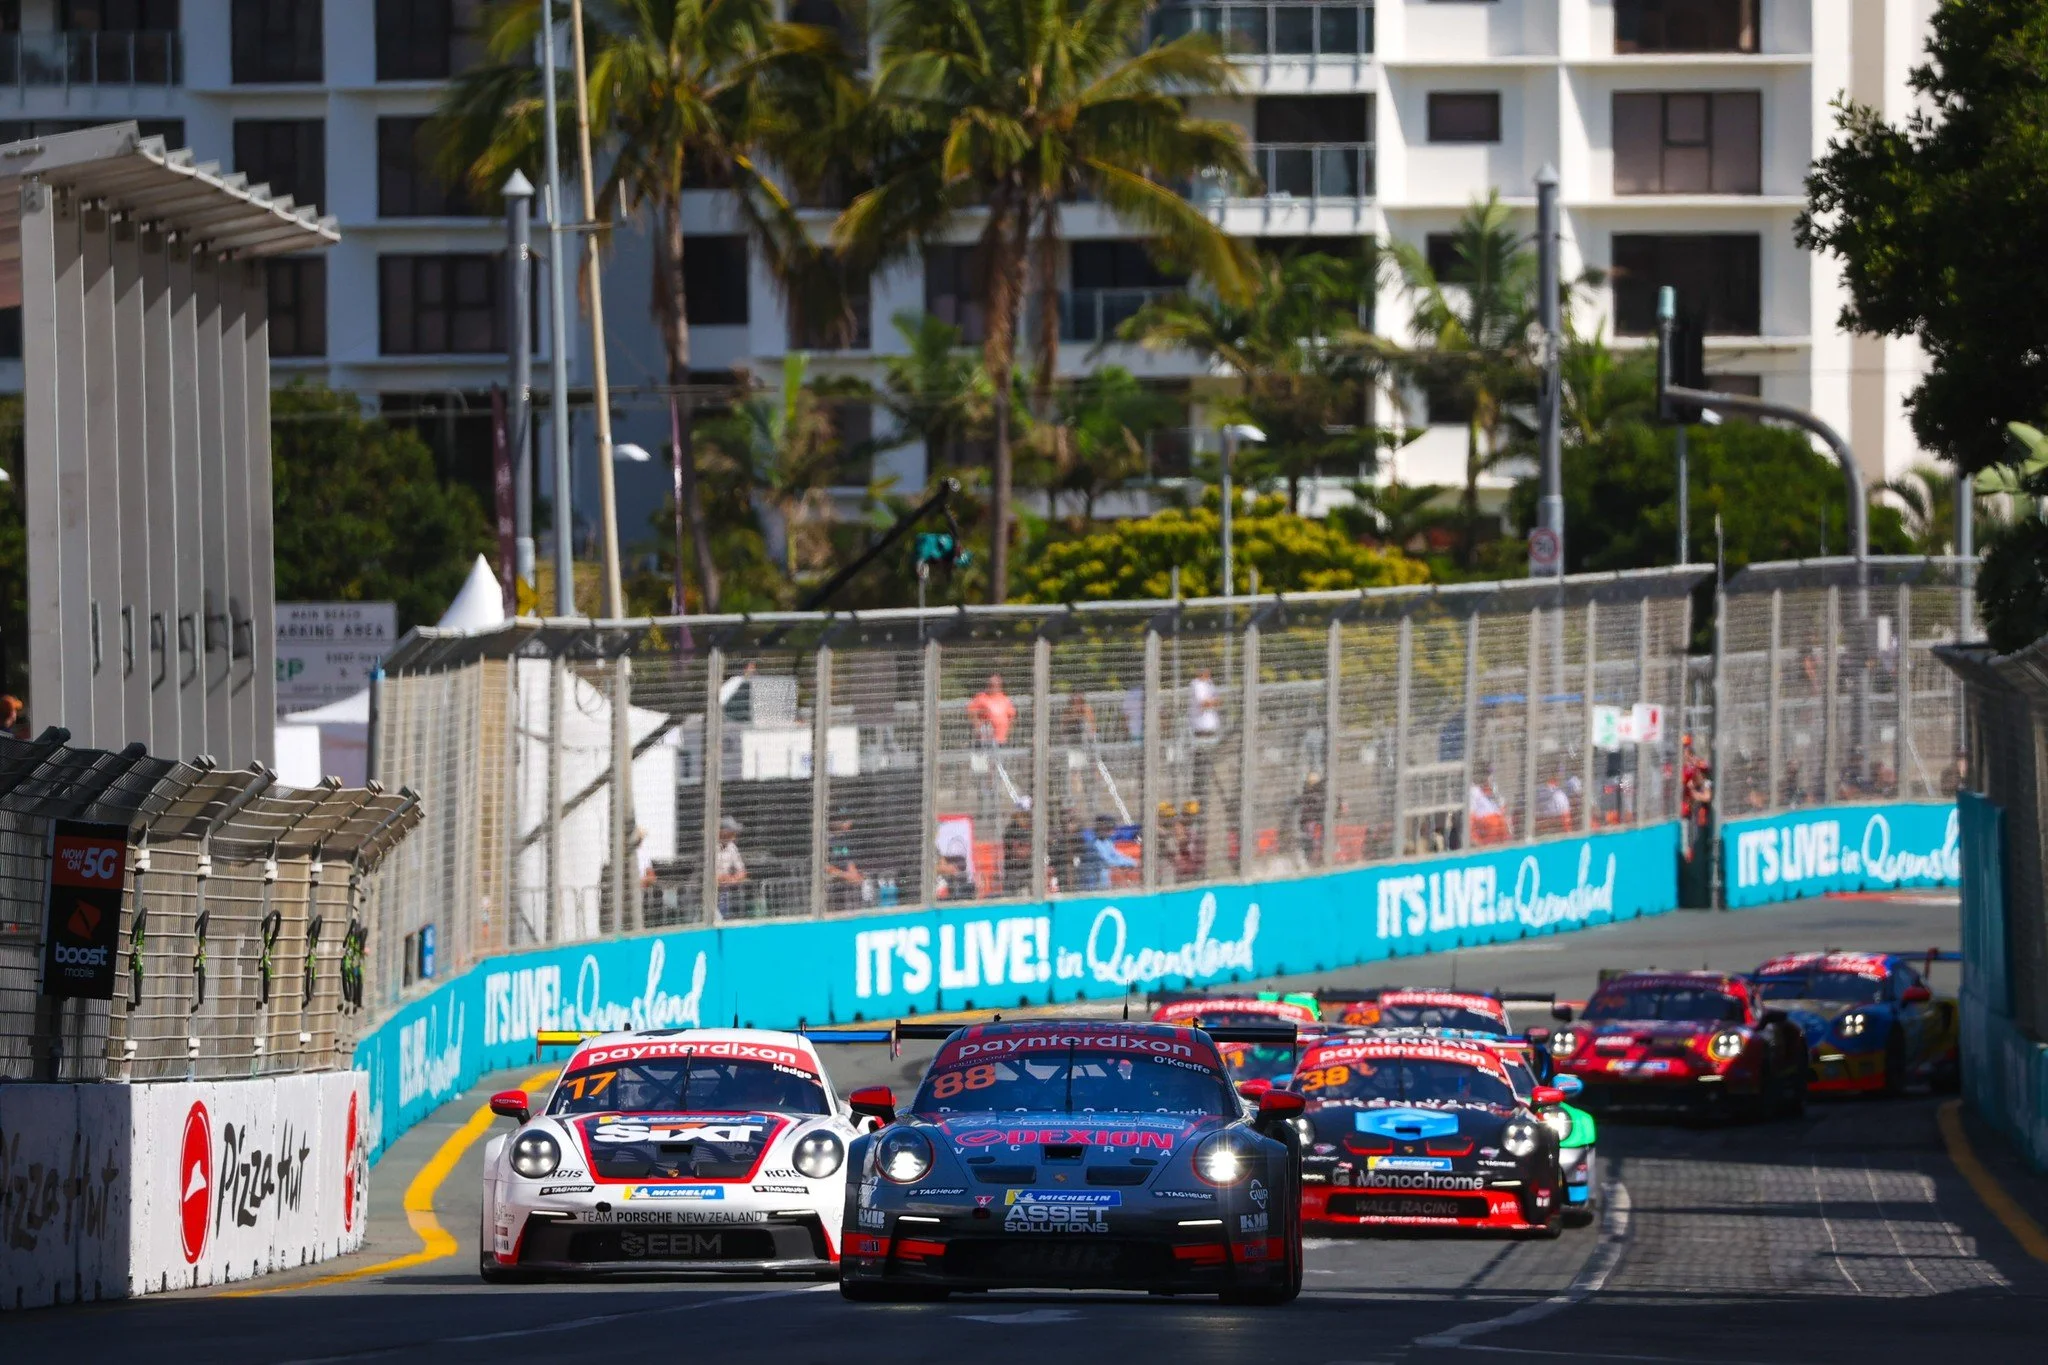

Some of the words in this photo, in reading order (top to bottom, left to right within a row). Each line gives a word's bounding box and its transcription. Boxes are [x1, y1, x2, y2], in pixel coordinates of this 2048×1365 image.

[277, 624, 334, 636] ARKING
[62, 848, 85, 860] NOW
[81, 847, 118, 880] 5G
[1738, 827, 1779, 888] IT'S
[1780, 820, 1840, 881] LIVE!
[1841, 845, 1861, 874] in
[67, 860, 82, 871] ON
[1377, 874, 1427, 939] IT'S
[1429, 865, 1496, 932] LIVE!
[1497, 892, 1515, 922] in
[1515, 841, 1616, 927] Queensland
[55, 942, 108, 966] boost
[856, 926, 931, 998] IT'S
[939, 917, 1051, 989] LIVE!
[1056, 946, 1084, 978] in
[1087, 892, 1260, 985] Queensland
[64, 967, 95, 978] mobile
[484, 972, 512, 1046] IT'S
[512, 965, 561, 1044] LIVE!
[589, 1042, 796, 1066] paynterdixon
[958, 1034, 1191, 1059] paynterdixon
[1319, 1043, 1486, 1064] paynterdixon
[1348, 1037, 1478, 1051] BRENNAN
[773, 1063, 812, 1079] Hedge
[1153, 1055, 1211, 1075] O'Keeffe
[1477, 1066, 1499, 1078] Wall
[567, 1071, 618, 1100] 17
[933, 1064, 996, 1099] 88
[1302, 1065, 1349, 1092] 38
[594, 1123, 763, 1142] SIXT
[1006, 1130, 1174, 1149] DEXION
[63, 1131, 120, 1246] Hut
[216, 1122, 275, 1239] Pizza
[277, 1118, 310, 1221] Hut
[1356, 1170, 1483, 1190] Monochrome
[652, 1189, 716, 1197] MICHELIN
[1038, 1194, 1111, 1202] MICHELIN
[1250, 1189, 1268, 1200] GWR
[581, 1212, 613, 1222] TEAM
[617, 1211, 672, 1222] PORSCHE
[677, 1211, 705, 1222] NEW
[708, 1211, 762, 1222] ZEALAND
[1004, 1205, 1109, 1222] ASSET
[1355, 1200, 1396, 1213] WALL
[1401, 1200, 1459, 1214] RACING
[1004, 1222, 1109, 1233] SOLUTIONS
[648, 1233, 722, 1255] EBM
